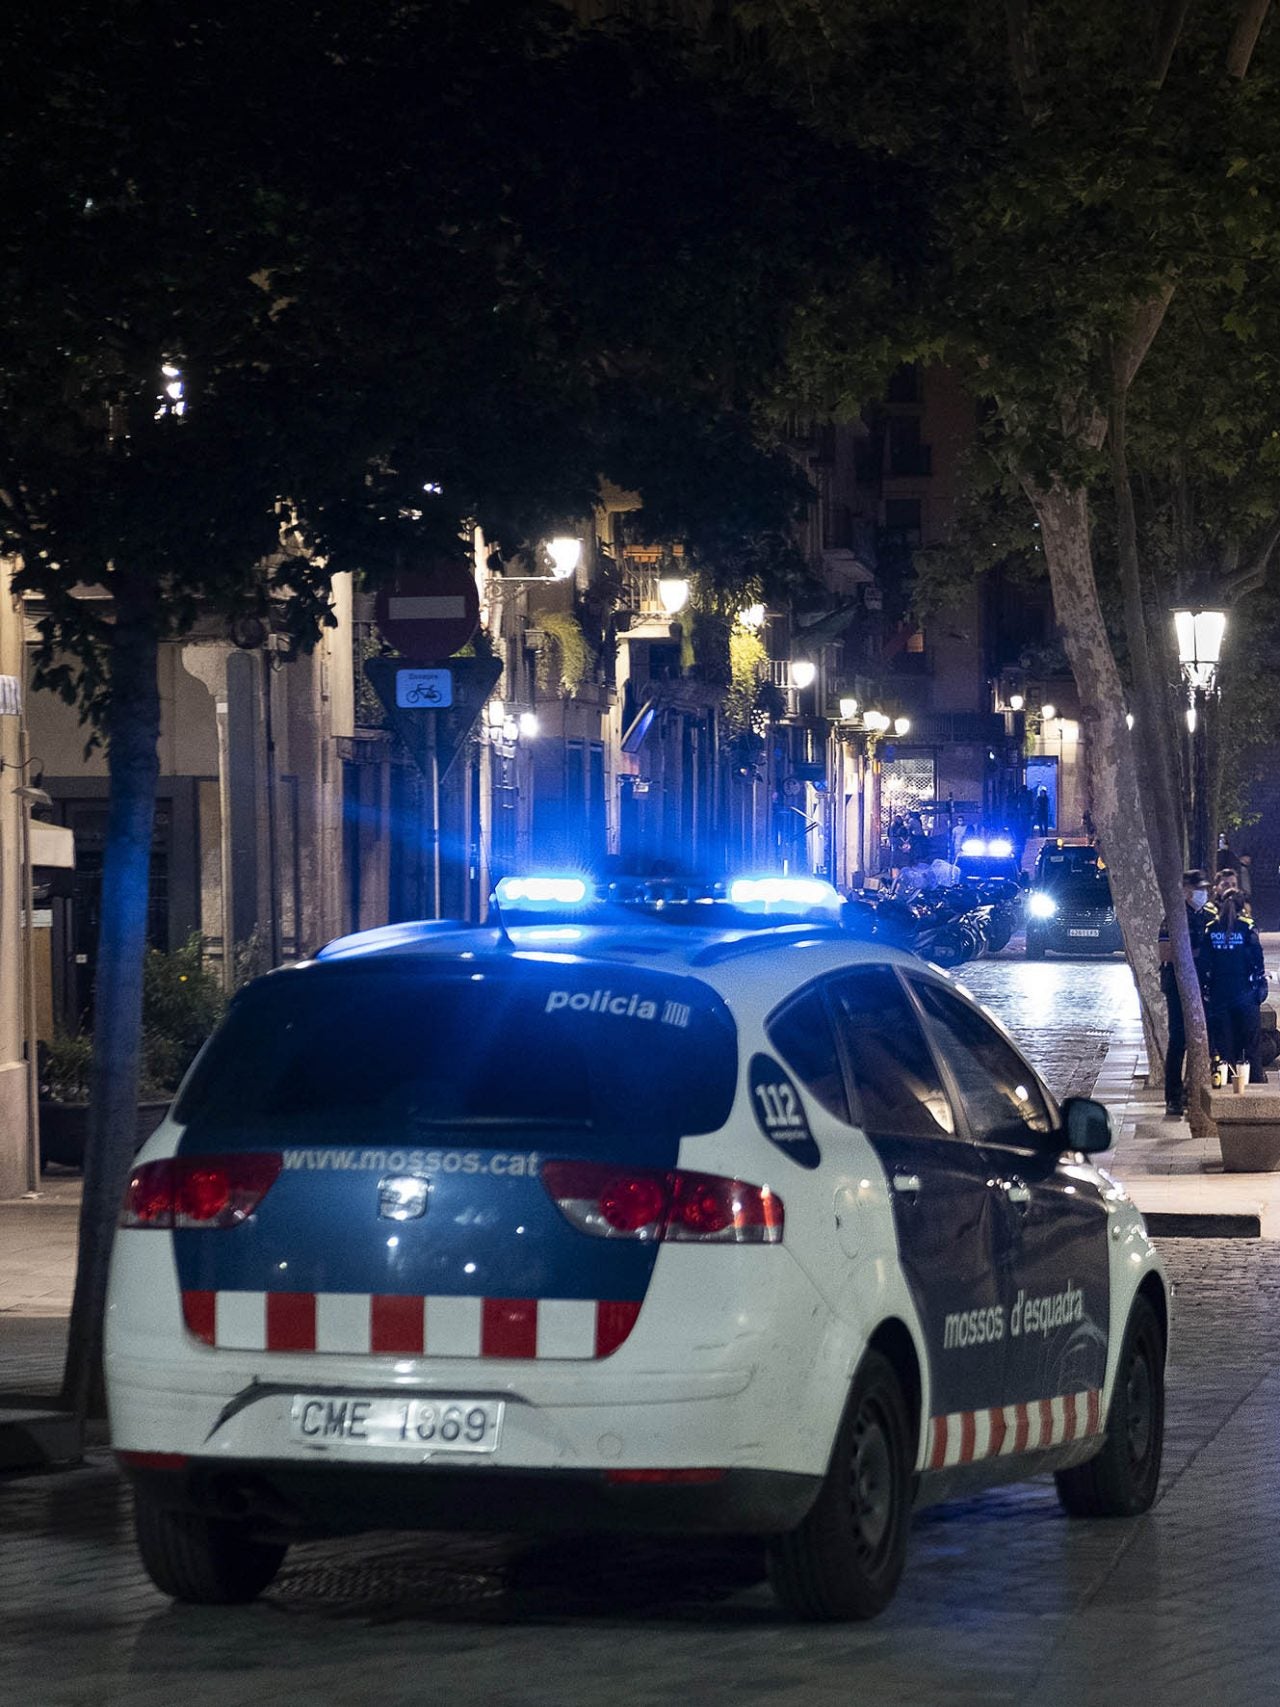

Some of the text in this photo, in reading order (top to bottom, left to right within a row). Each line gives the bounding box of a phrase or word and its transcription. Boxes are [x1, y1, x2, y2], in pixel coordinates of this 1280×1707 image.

[545, 990, 656, 1020] policia
[755, 1083, 801, 1126] 112
[282, 1148, 539, 1177] www.mossos.cat
[943, 1278, 1085, 1349] mossos d'esquadra
[302, 1401, 372, 1438] CME
